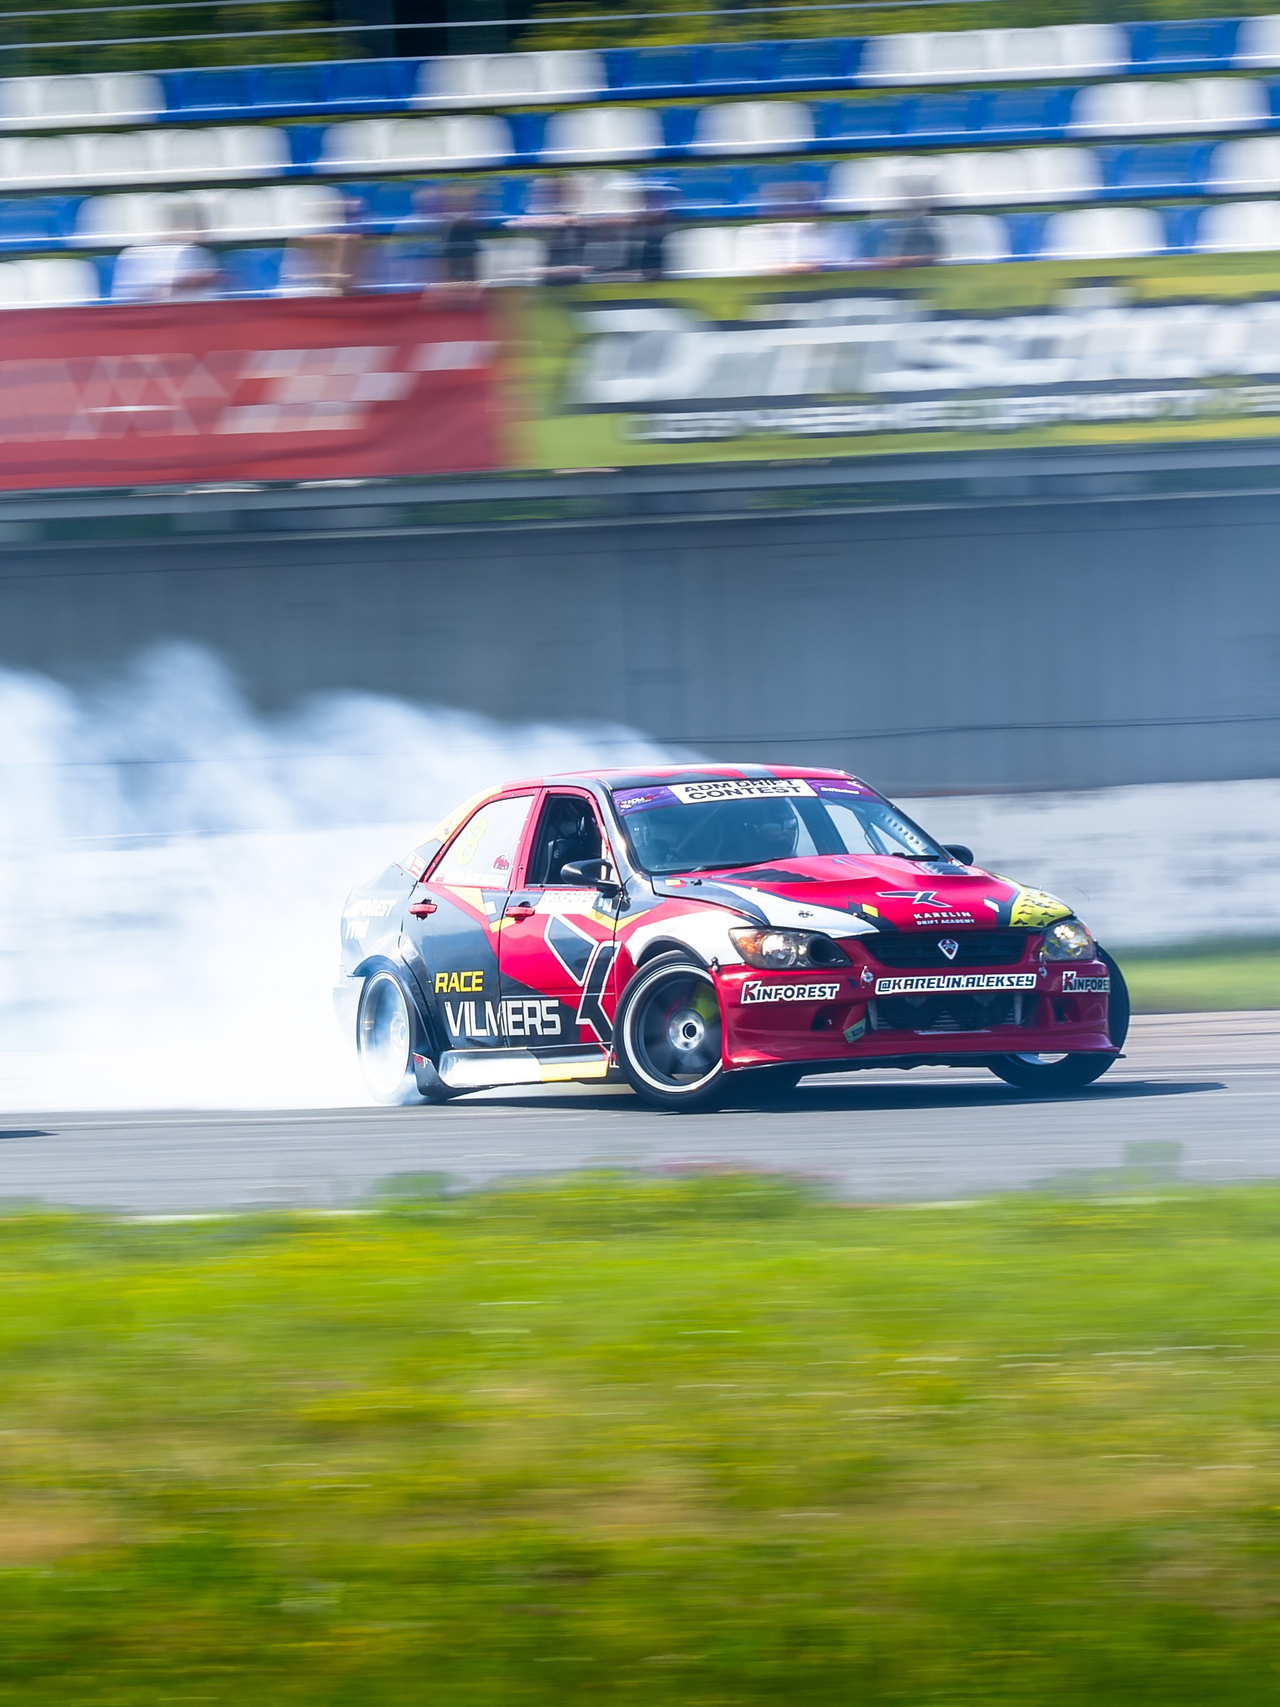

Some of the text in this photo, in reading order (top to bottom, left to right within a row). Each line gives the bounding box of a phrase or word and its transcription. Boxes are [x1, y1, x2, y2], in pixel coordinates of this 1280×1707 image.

[685, 779, 794, 793] ADM DRIFT
[689, 786, 801, 800] CONTEST
[913, 911, 971, 919] KARELIN
[434, 971, 484, 993] RACE
[877, 975, 1035, 992] @KARELIN.ALEKSEY
[1063, 973, 1110, 990] KINFORE
[743, 983, 838, 1001] KINFOREST
[444, 1000, 561, 1036] VILMERS
